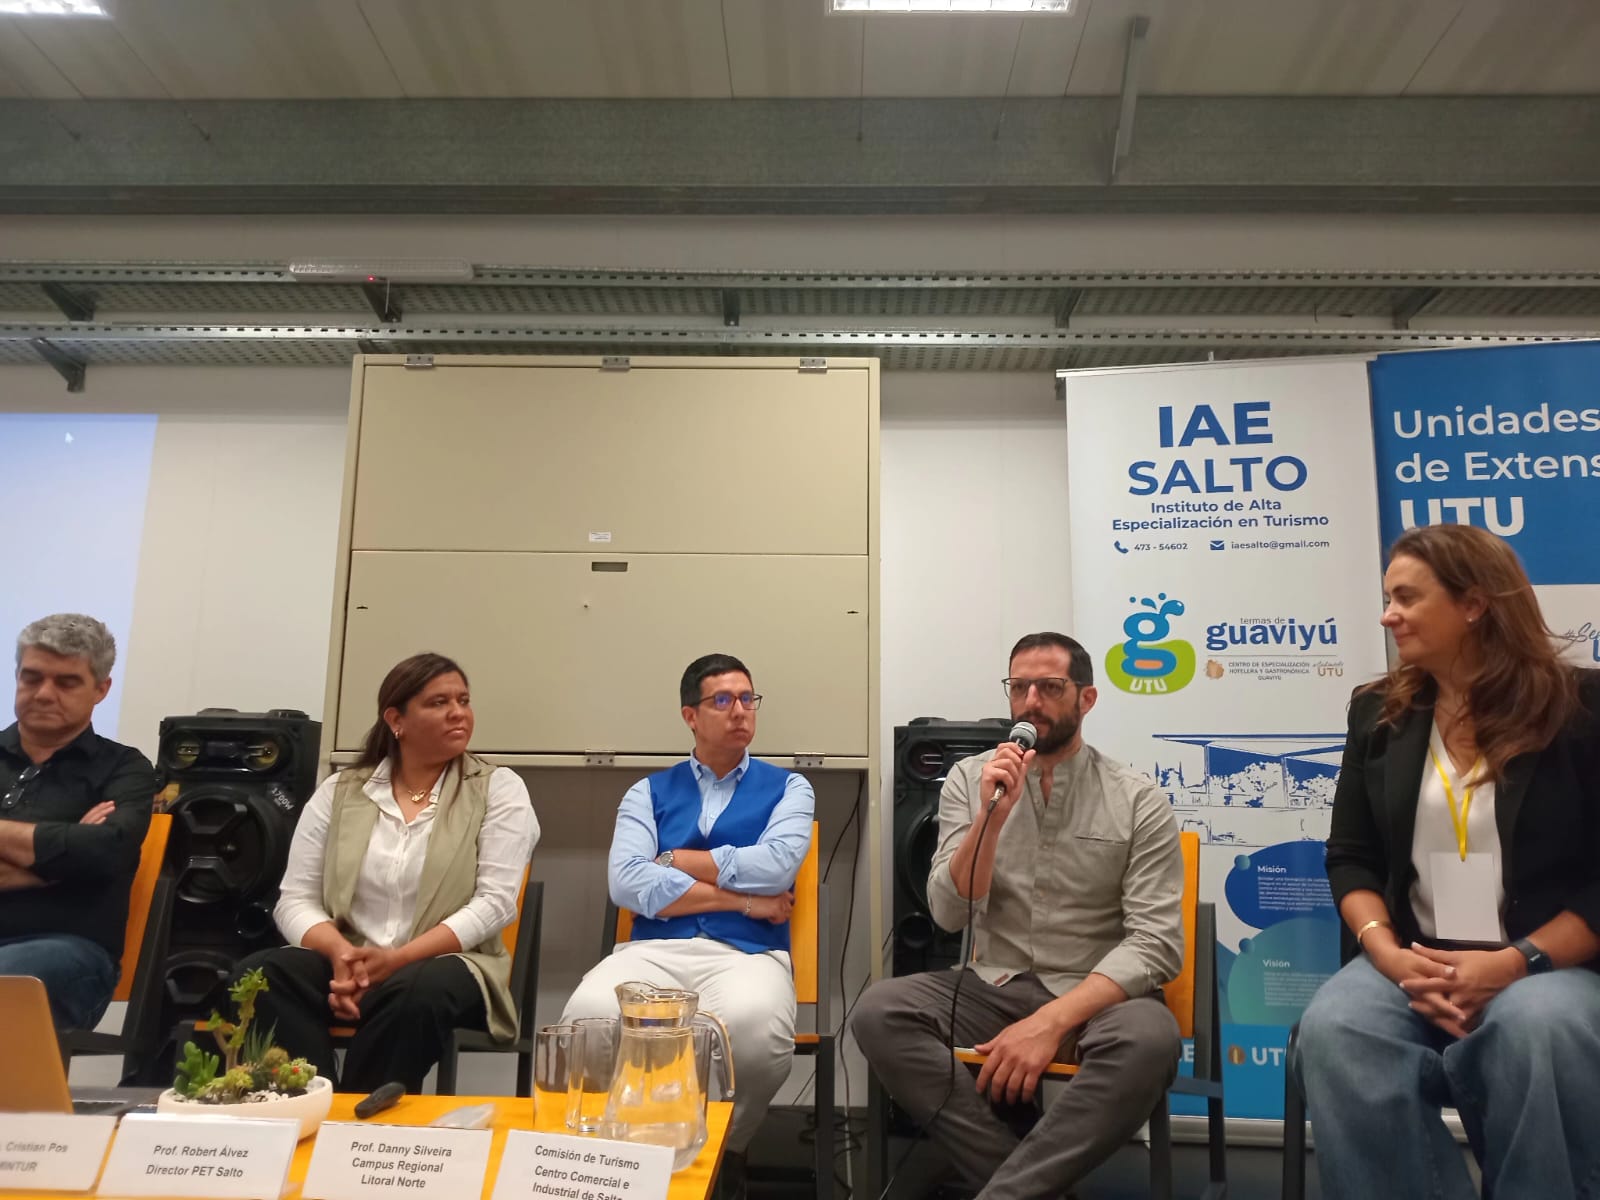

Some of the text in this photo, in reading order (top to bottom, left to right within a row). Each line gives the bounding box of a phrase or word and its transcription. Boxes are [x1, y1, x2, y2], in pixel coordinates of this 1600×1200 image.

[1159, 401, 1273, 448] IAE
[1394, 402, 1600, 439] Unidades
[1128, 455, 1308, 496] SALTO
[1395, 452, 1450, 483] de
[1151, 499, 1282, 514] Instituto de Alta
[1112, 514, 1329, 532] Especialización en Turismo
[1400, 496, 1525, 537] UTU
[1133, 543, 1151, 551] 473
[1159, 542, 1188, 551] 54602
[1231, 540, 1330, 550] iaesalto@gmail.com
[1240, 617, 1272, 625] termas
[1206, 617, 1338, 651] guaviyú
[1317, 667, 1344, 677] UTU
[1129, 678, 1168, 693] UTU
[1257, 865, 1287, 873] Misión
[1262, 959, 1290, 968] Visión
[1251, 1046, 1286, 1067] UT
[6, 1141, 69, 1153] Cristian Pos
[153, 1145, 249, 1158] Prof. Robert Álvez
[350, 1141, 452, 1157] Prof. Danny Silveira
[352, 1157, 444, 1173] Campus Regional
[534, 1145, 640, 1170] Comisión de Turismo
[145, 1164, 244, 1178] Director PET Salto
[534, 1165, 630, 1189] Centro Comercial e
[361, 1174, 426, 1188] Litoral Norte
[532, 1182, 580, 1199] Industrial
[581, 1191, 594, 1200] de
